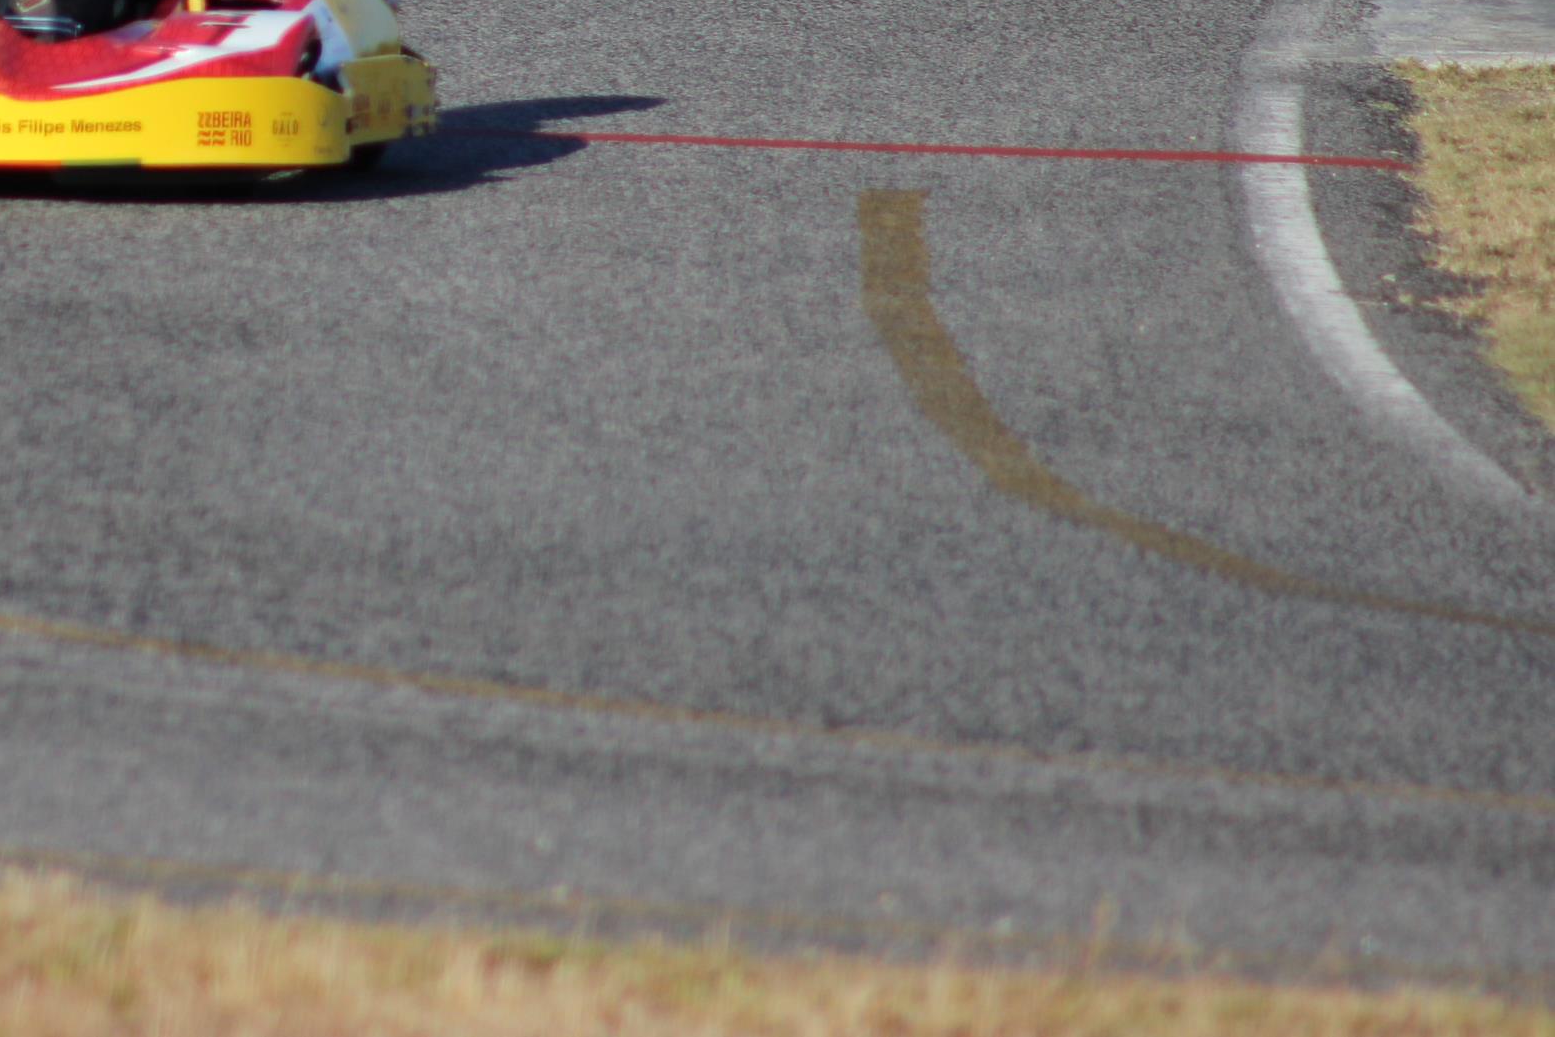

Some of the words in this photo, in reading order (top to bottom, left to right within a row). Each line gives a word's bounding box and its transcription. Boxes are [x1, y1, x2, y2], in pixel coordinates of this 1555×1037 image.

[18, 119, 65, 136] Filipe
[71, 119, 142, 133] Menezes
[212, 111, 252, 128] BEIRA
[230, 130, 252, 147] RIO
